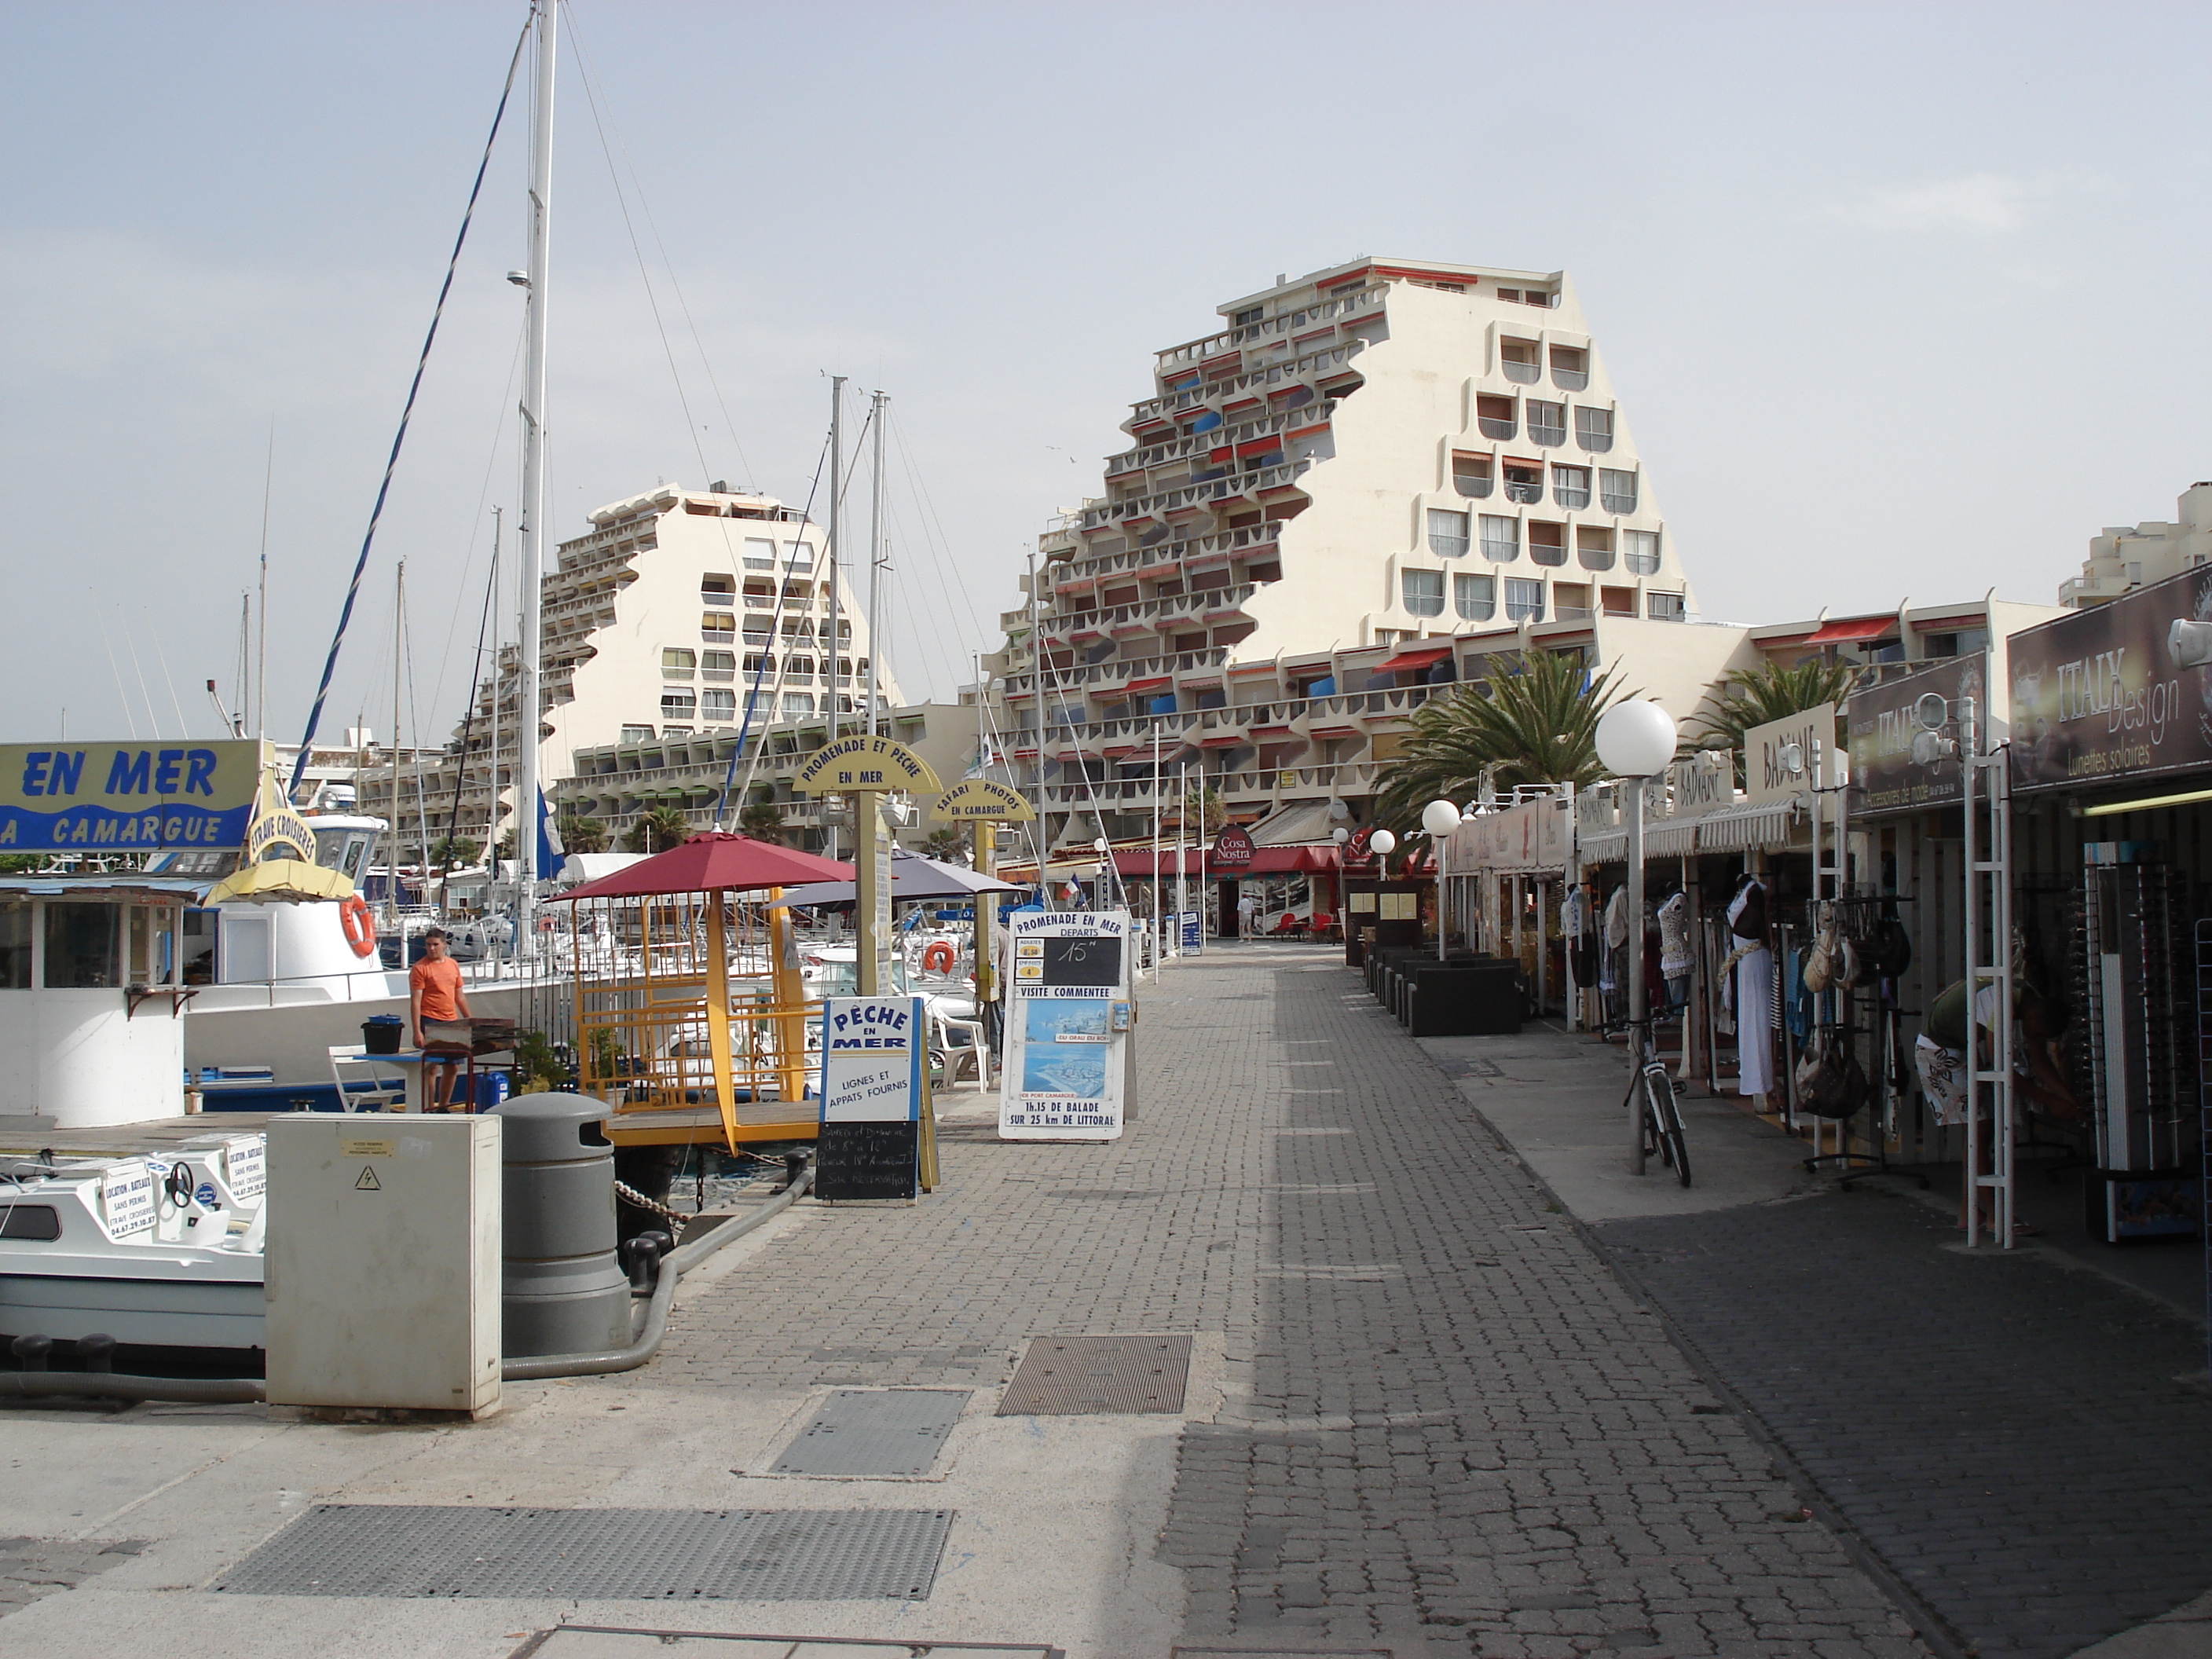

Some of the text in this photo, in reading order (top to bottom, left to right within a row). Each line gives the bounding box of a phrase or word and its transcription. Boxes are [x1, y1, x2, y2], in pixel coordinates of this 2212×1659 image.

[2057, 648, 2126, 723] ITALY
[2108, 671, 2179, 745] Design
[801, 739, 921, 782] PROMENADE ET PECHE
[2068, 735, 2151, 777] Lunettes solaires
[22, 749, 217, 797] EN MER
[839, 771, 883, 783] EN MER
[937, 783, 1020, 811] SAFARI PHOTOS
[951, 805, 1005, 815] EN CAMARGUE
[53, 815, 222, 844] CAMARGUE
[251, 815, 314, 859] ETRAVE CROISIERES
[1221, 837, 1246, 848] Cosa
[1218, 848, 1250, 859] Nostra
[1016, 914, 1077, 933] PROMENADE
[1082, 915, 1095, 926] EN
[1100, 919, 1121, 935] MER
[1021, 987, 1110, 997] VISITE COMMENTEE
[833, 1038, 906, 1048] MER
[842, 1071, 889, 1090] LIGNES ET
[830, 1080, 907, 1108] APPATS FOURNIS
[1051, 1102, 1061, 1111] DE
[1067, 1102, 1099, 1112] BALADE
[1010, 1114, 1114, 1125] SUR 25 km DE LITTORAL
[235, 1163, 260, 1177] SANS PERMIS
[106, 1177, 151, 1199] LOCATION BATEAUX
[114, 1195, 147, 1211] SANS PERMIS
